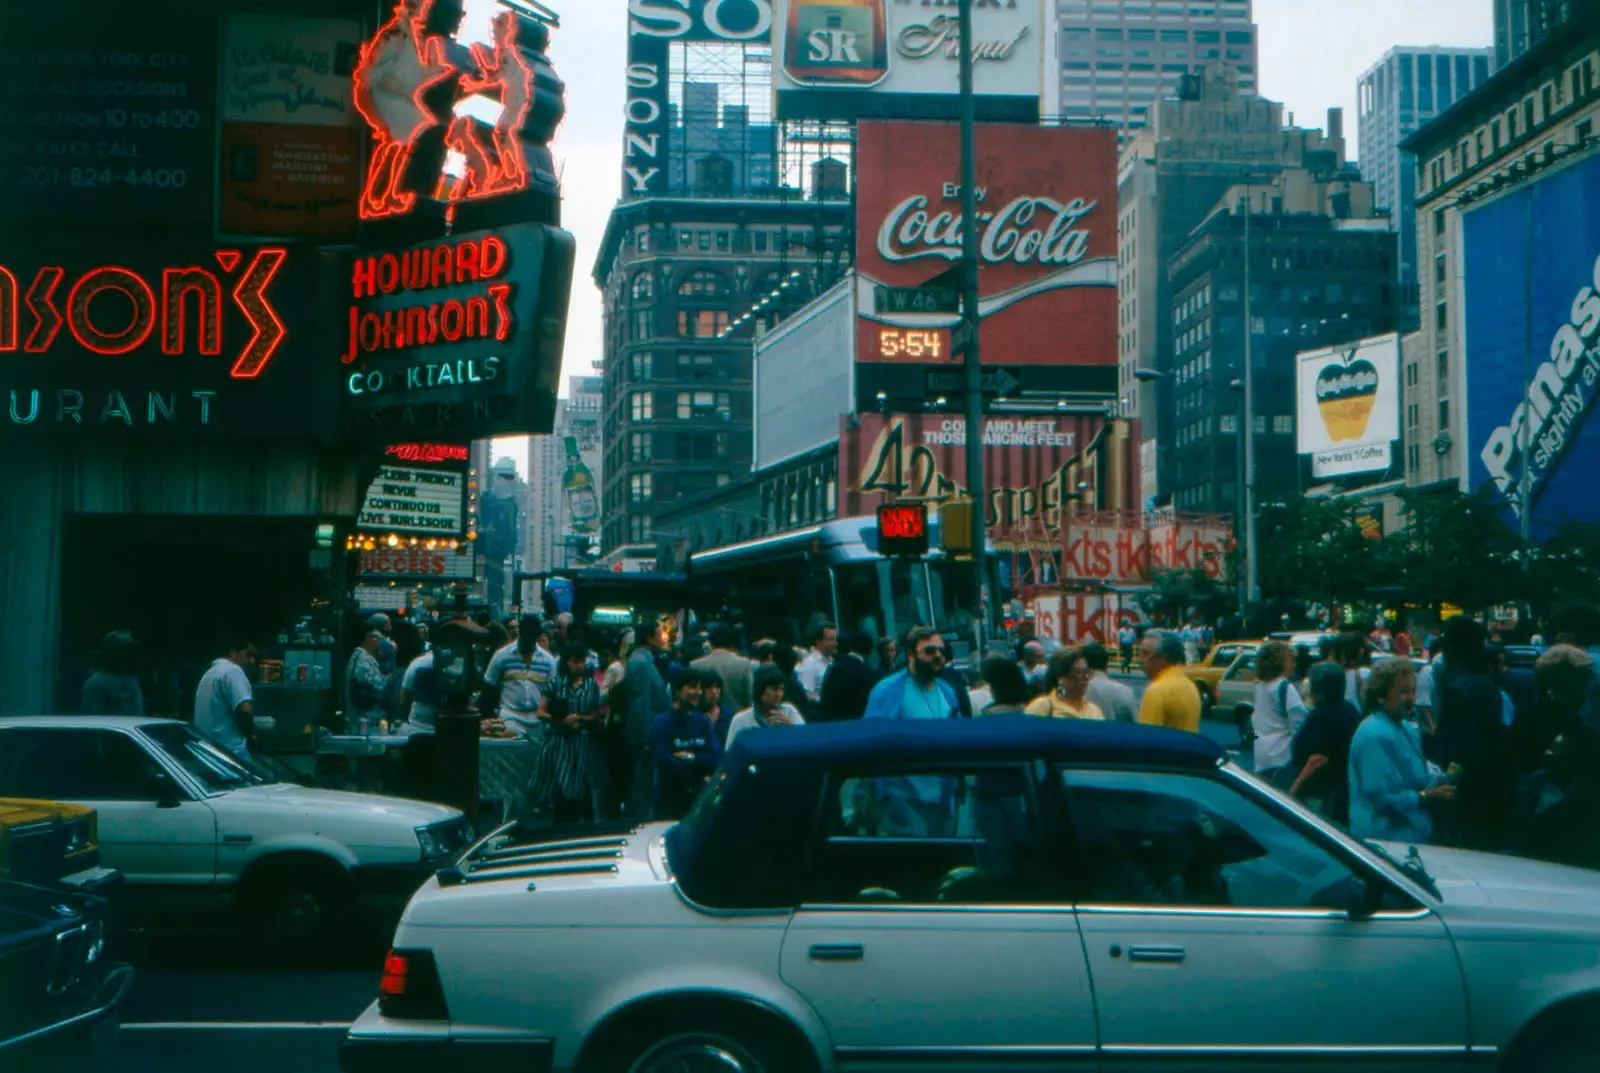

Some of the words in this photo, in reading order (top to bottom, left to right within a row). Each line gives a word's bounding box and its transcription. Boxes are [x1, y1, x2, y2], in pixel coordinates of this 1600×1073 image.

[808, 28, 862, 63] SR
[149, 53, 189, 68] CITY
[104, 108, 127, 127] 10
[155, 109, 200, 129] 400
[624, 63, 660, 191] SONY
[942, 182, 988, 201] Eny
[352, 235, 506, 298] HOWARD
[892, 291, 907, 310] W
[912, 290, 938, 312] 46
[341, 283, 511, 364] JOHNSON'S
[880, 331, 941, 357] 5:54
[1481, 252, 1600, 493] Panas
[985, 420, 1013, 434] AND
[1015, 420, 1056, 434] MEET
[982, 432, 1035, 446] ANCING
[1036, 433, 1075, 447] FEET
